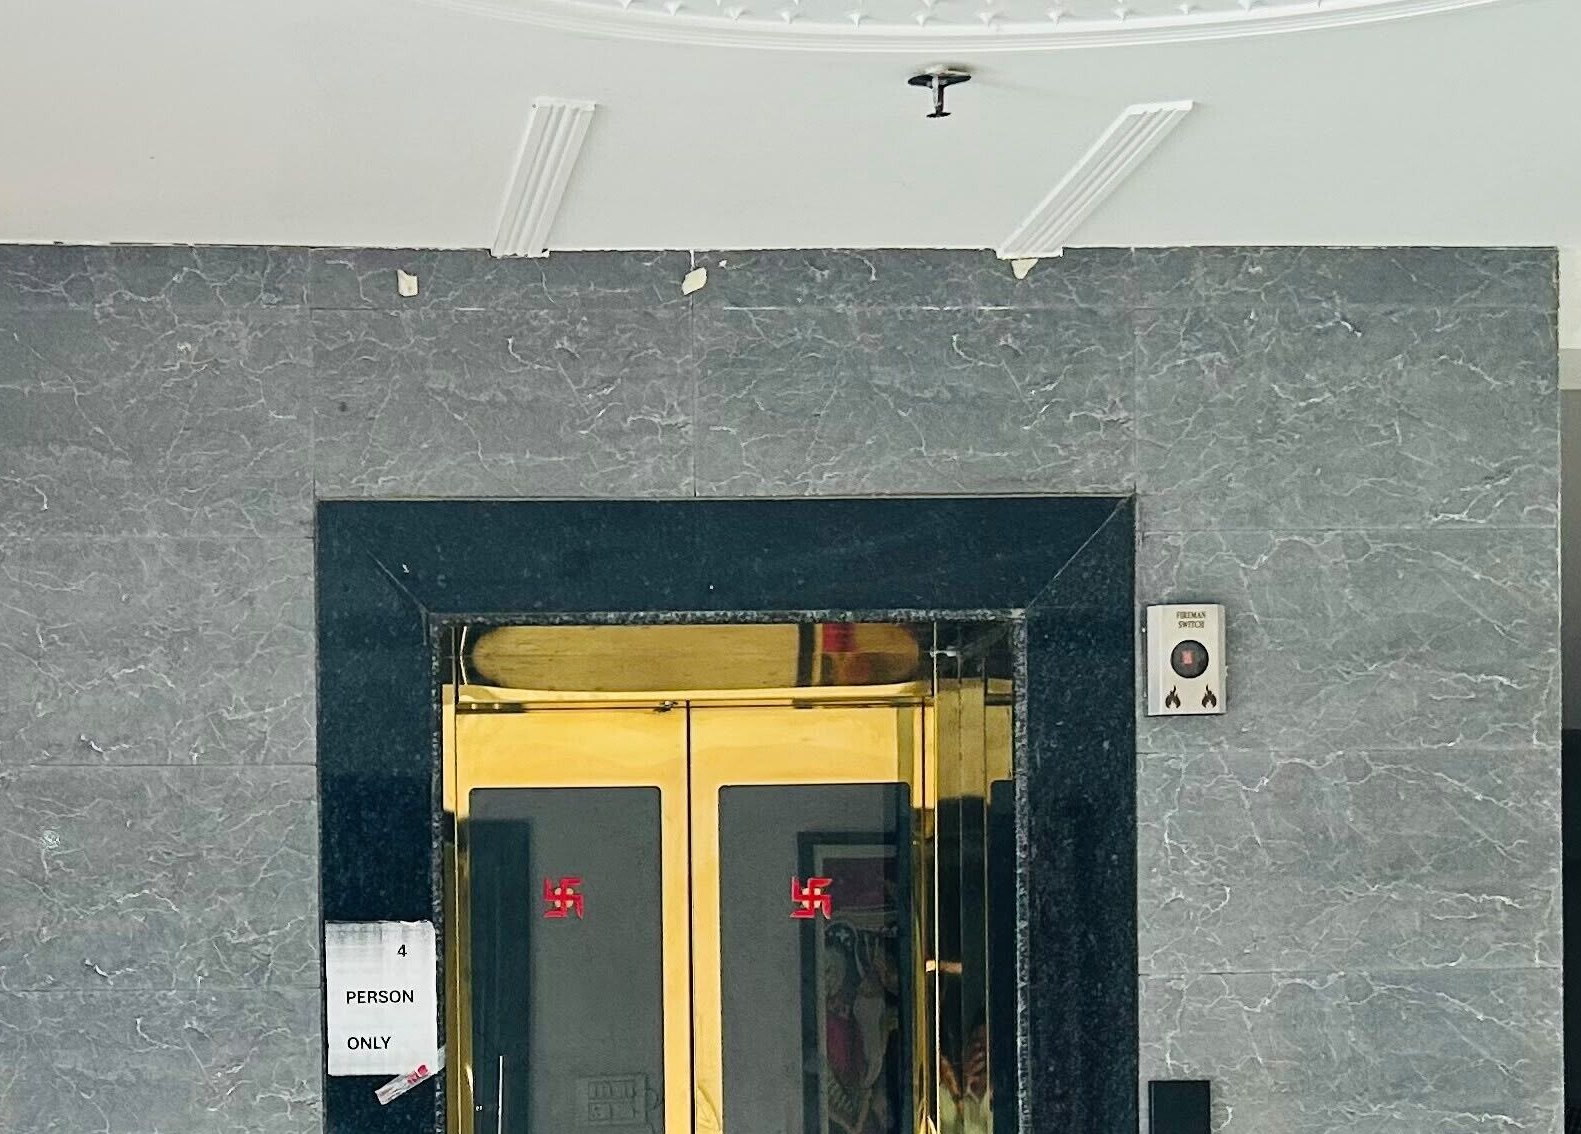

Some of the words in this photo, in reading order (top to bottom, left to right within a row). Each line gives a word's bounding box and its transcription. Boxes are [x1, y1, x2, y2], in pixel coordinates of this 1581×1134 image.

[1176, 611, 1206, 619] FIREMAN
[1178, 621, 1205, 629] SWITCH
[397, 944, 408, 958] 4
[346, 989, 414, 1004] PERSON
[347, 1036, 392, 1050] ONLY
